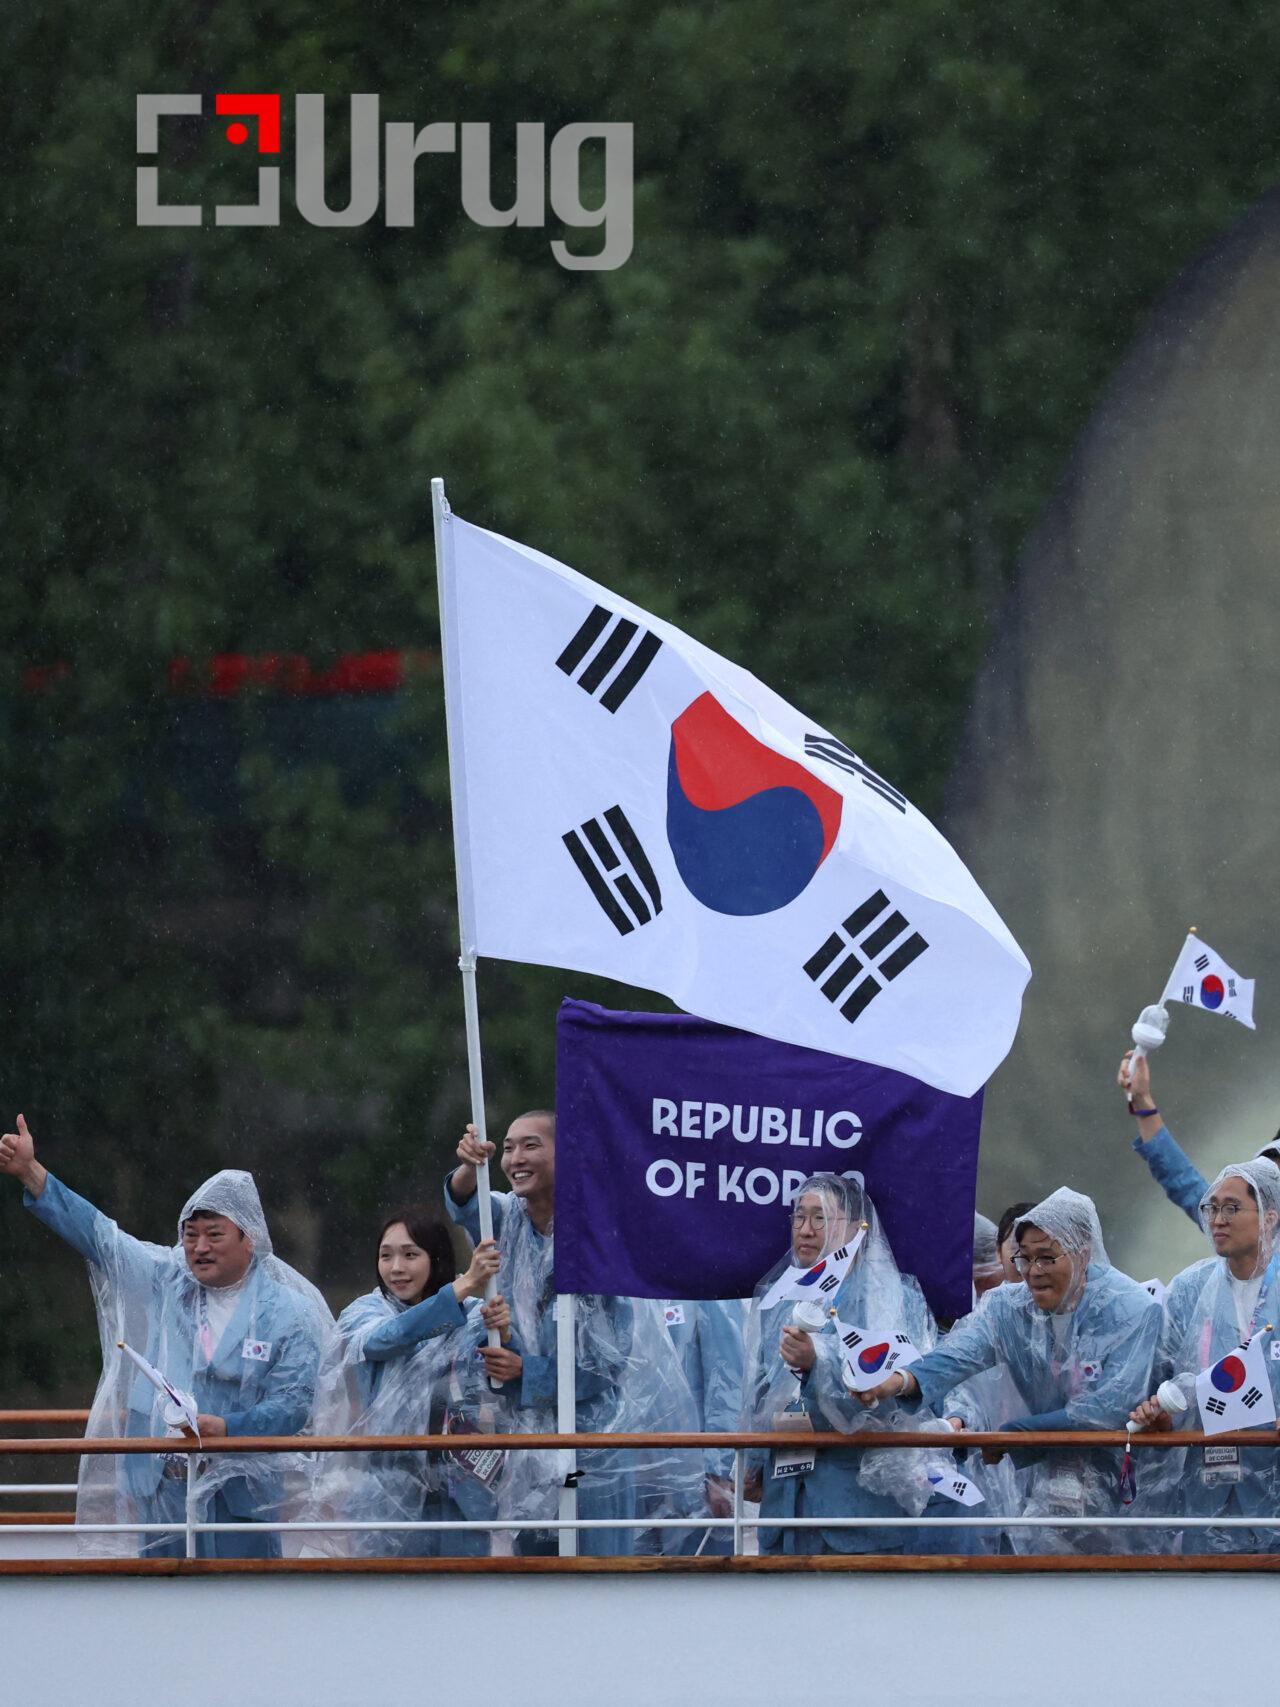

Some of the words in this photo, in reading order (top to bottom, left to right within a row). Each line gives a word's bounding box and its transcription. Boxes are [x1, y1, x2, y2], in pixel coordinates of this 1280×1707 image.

[652, 1097, 863, 1149] REPUBLIC
[645, 1158, 706, 1199] OF
[718, 1164, 865, 1207] KOR
